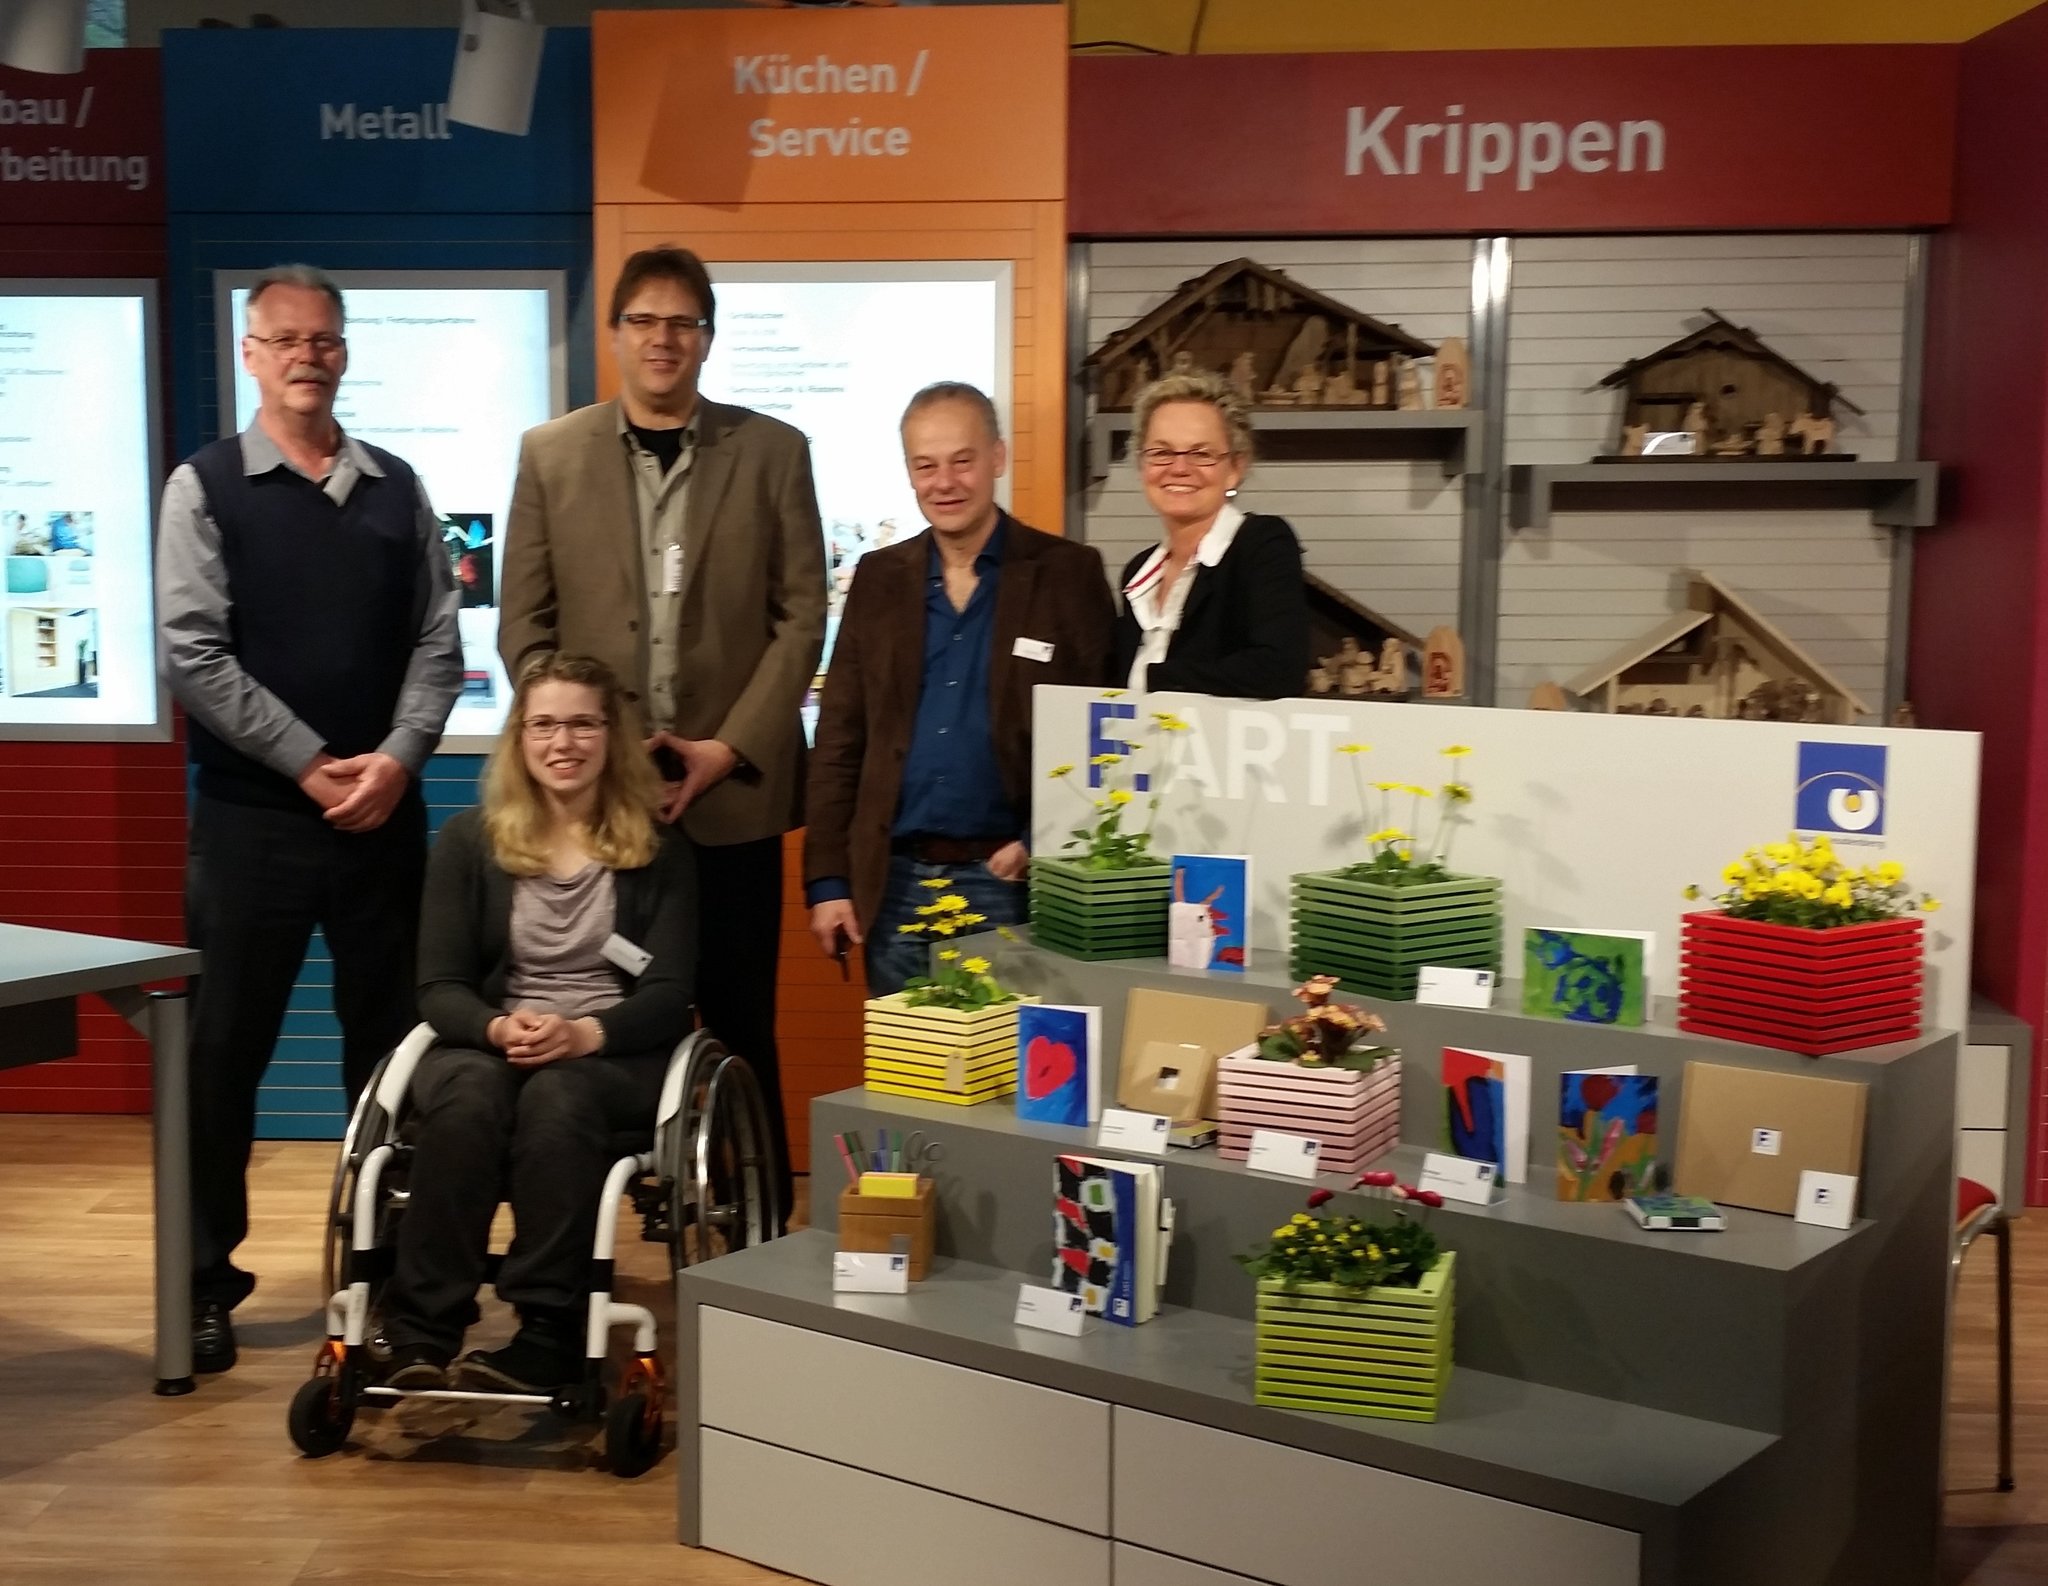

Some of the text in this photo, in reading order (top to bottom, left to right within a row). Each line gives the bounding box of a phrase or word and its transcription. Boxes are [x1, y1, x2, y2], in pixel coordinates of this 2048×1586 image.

[734, 49, 929, 96] Küchen /
[319, 103, 453, 139] Metall
[749, 117, 912, 157] Service
[0, 146, 149, 190] beitung
[1345, 104, 1665, 191] Krippen
